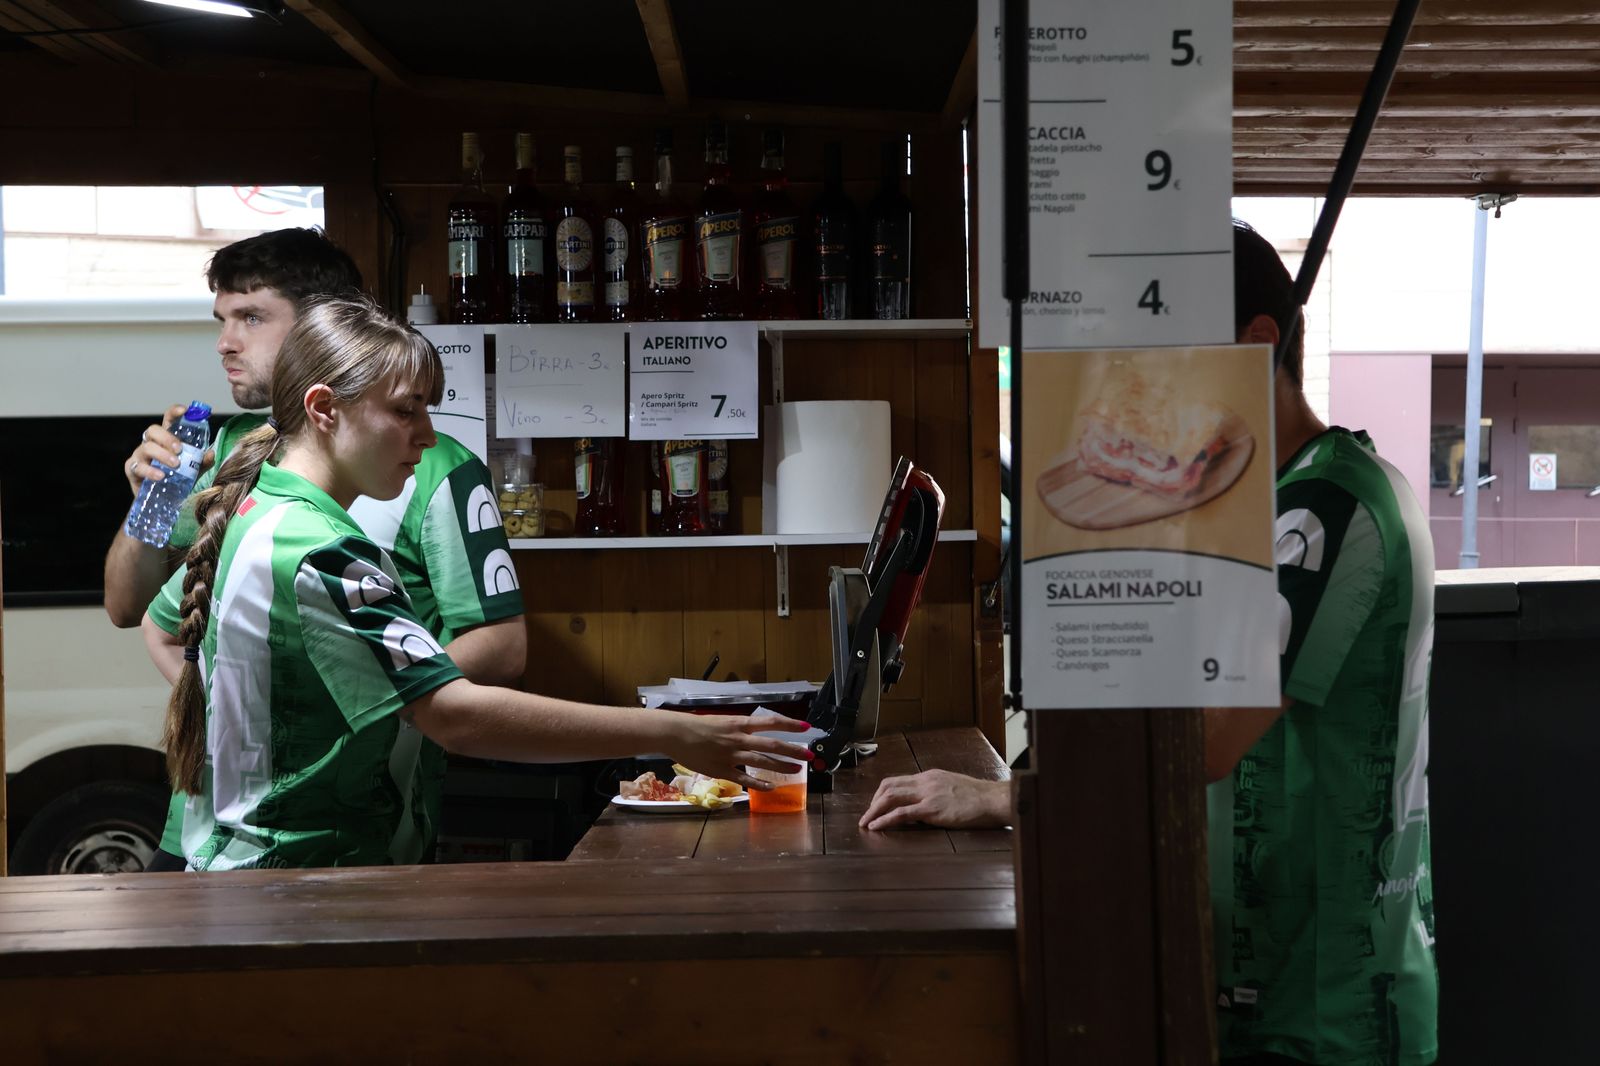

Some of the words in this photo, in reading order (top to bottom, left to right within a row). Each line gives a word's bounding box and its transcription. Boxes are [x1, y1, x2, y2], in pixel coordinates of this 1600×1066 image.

[1062, 53, 1091, 65] funghi
[1026, 126, 1086, 140] CACCIA
[1061, 143, 1102, 154] pistacho
[1060, 193, 1087, 201] cotto
[1044, 203, 1076, 214] Napoli
[700, 219, 740, 240] APEROL
[643, 336, 727, 350] APERITIVO
[436, 344, 471, 355] COTTO
[643, 356, 691, 366] ITALIANO
[447, 388, 456, 401] 9
[664, 392, 685, 400] Spritz
[677, 401, 698, 409] Spritz
[502, 397, 542, 428] Vino
[1045, 570, 1097, 580] FOCACCIA
[1099, 569, 1154, 579] GENOVESE
[1046, 582, 1121, 600] SALAMI
[1127, 580, 1202, 598] NAPOLI
[1055, 622, 1090, 632] Salami
[1091, 621, 1150, 633] (embutido)
[1056, 635, 1089, 646] Queso
[1091, 634, 1154, 644] Stracciatella
[1056, 648, 1089, 659] Queso
[1091, 647, 1142, 657] Scamorza
[1056, 660, 1110, 672] Canónigos
[1203, 657, 1219, 682] 9
